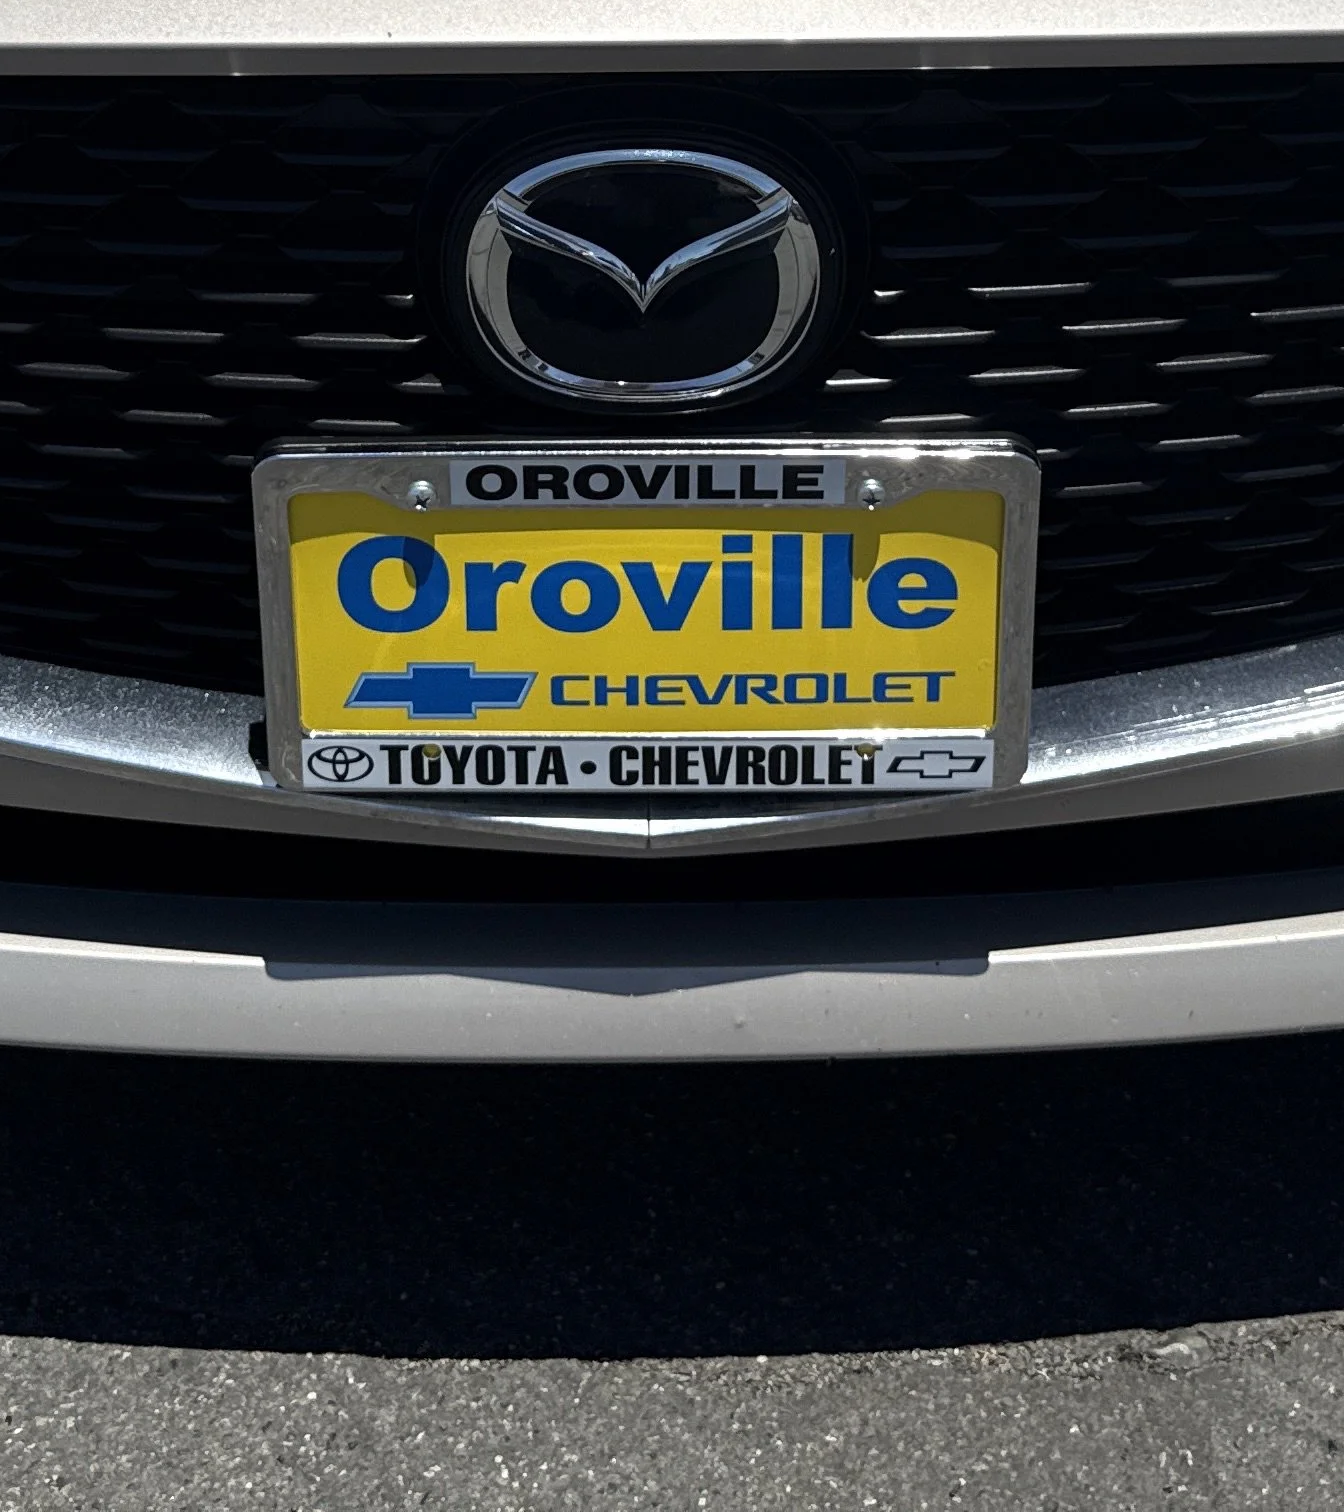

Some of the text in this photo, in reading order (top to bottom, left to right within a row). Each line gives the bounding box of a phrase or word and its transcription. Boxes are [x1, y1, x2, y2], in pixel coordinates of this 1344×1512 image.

[464, 464, 825, 501] OROVILLE
[337, 534, 958, 633] Oroville
[550, 671, 956, 707] CHEVROLET
[379, 744, 883, 786] TOYOTA CHEVROLET
